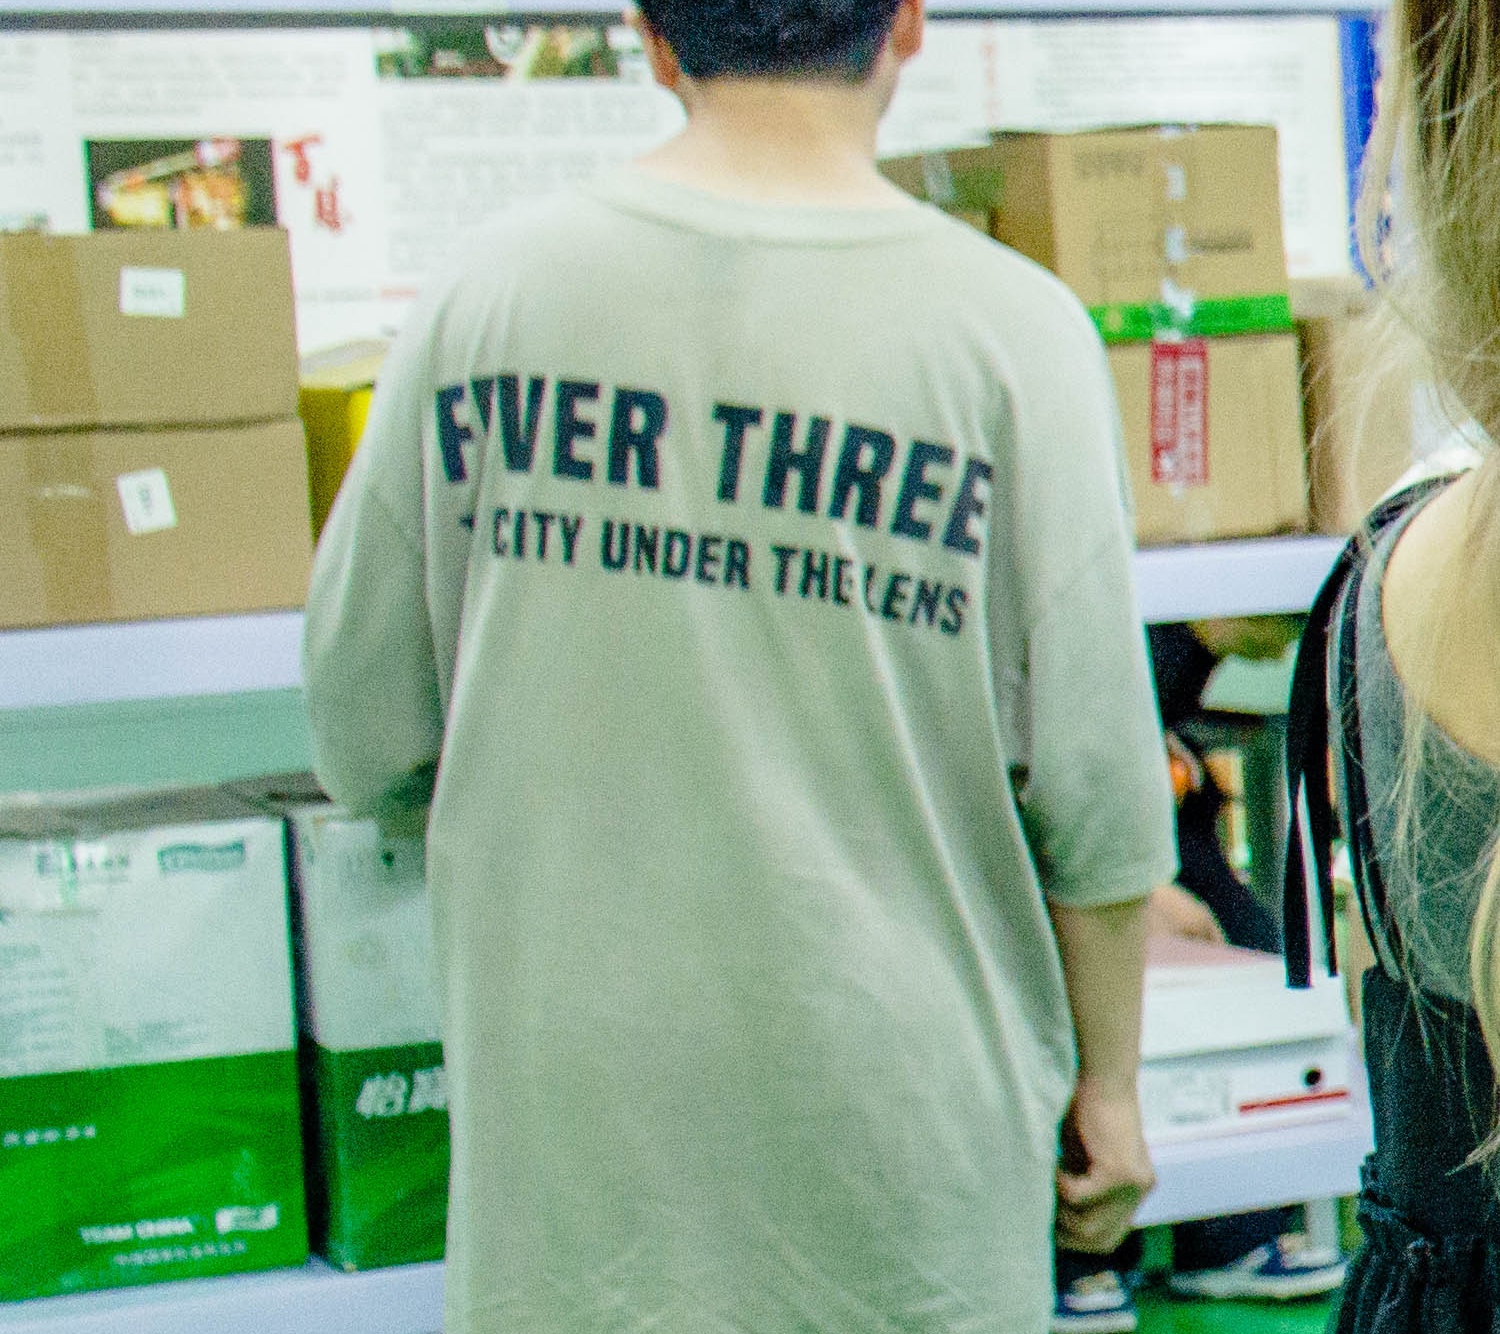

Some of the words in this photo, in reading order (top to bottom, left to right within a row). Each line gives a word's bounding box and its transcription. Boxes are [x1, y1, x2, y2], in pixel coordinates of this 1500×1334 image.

[711, 401, 994, 555] THREE
[492, 507, 584, 565] CITY
[601, 519, 751, 590] UNDER
[770, 543, 853, 605] THE
[863, 562, 969, 635] LENS
